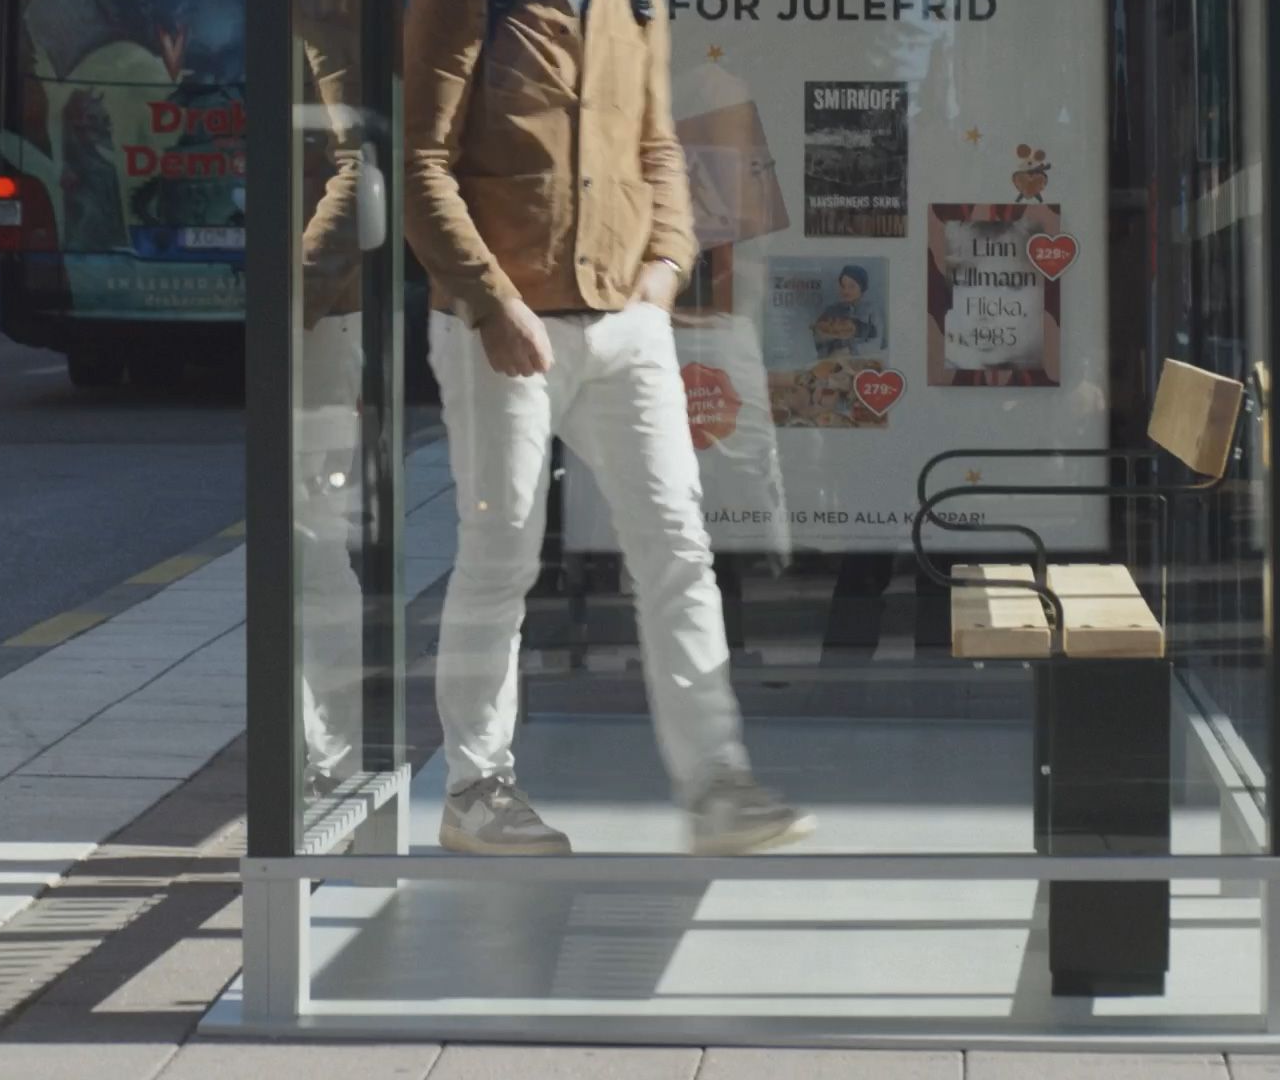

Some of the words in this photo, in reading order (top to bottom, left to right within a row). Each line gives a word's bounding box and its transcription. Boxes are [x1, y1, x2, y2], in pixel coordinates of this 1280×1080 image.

[972, 236, 1016, 258] Linn
[813, 511, 849, 524] MED
[855, 511, 897, 524] ALLA
